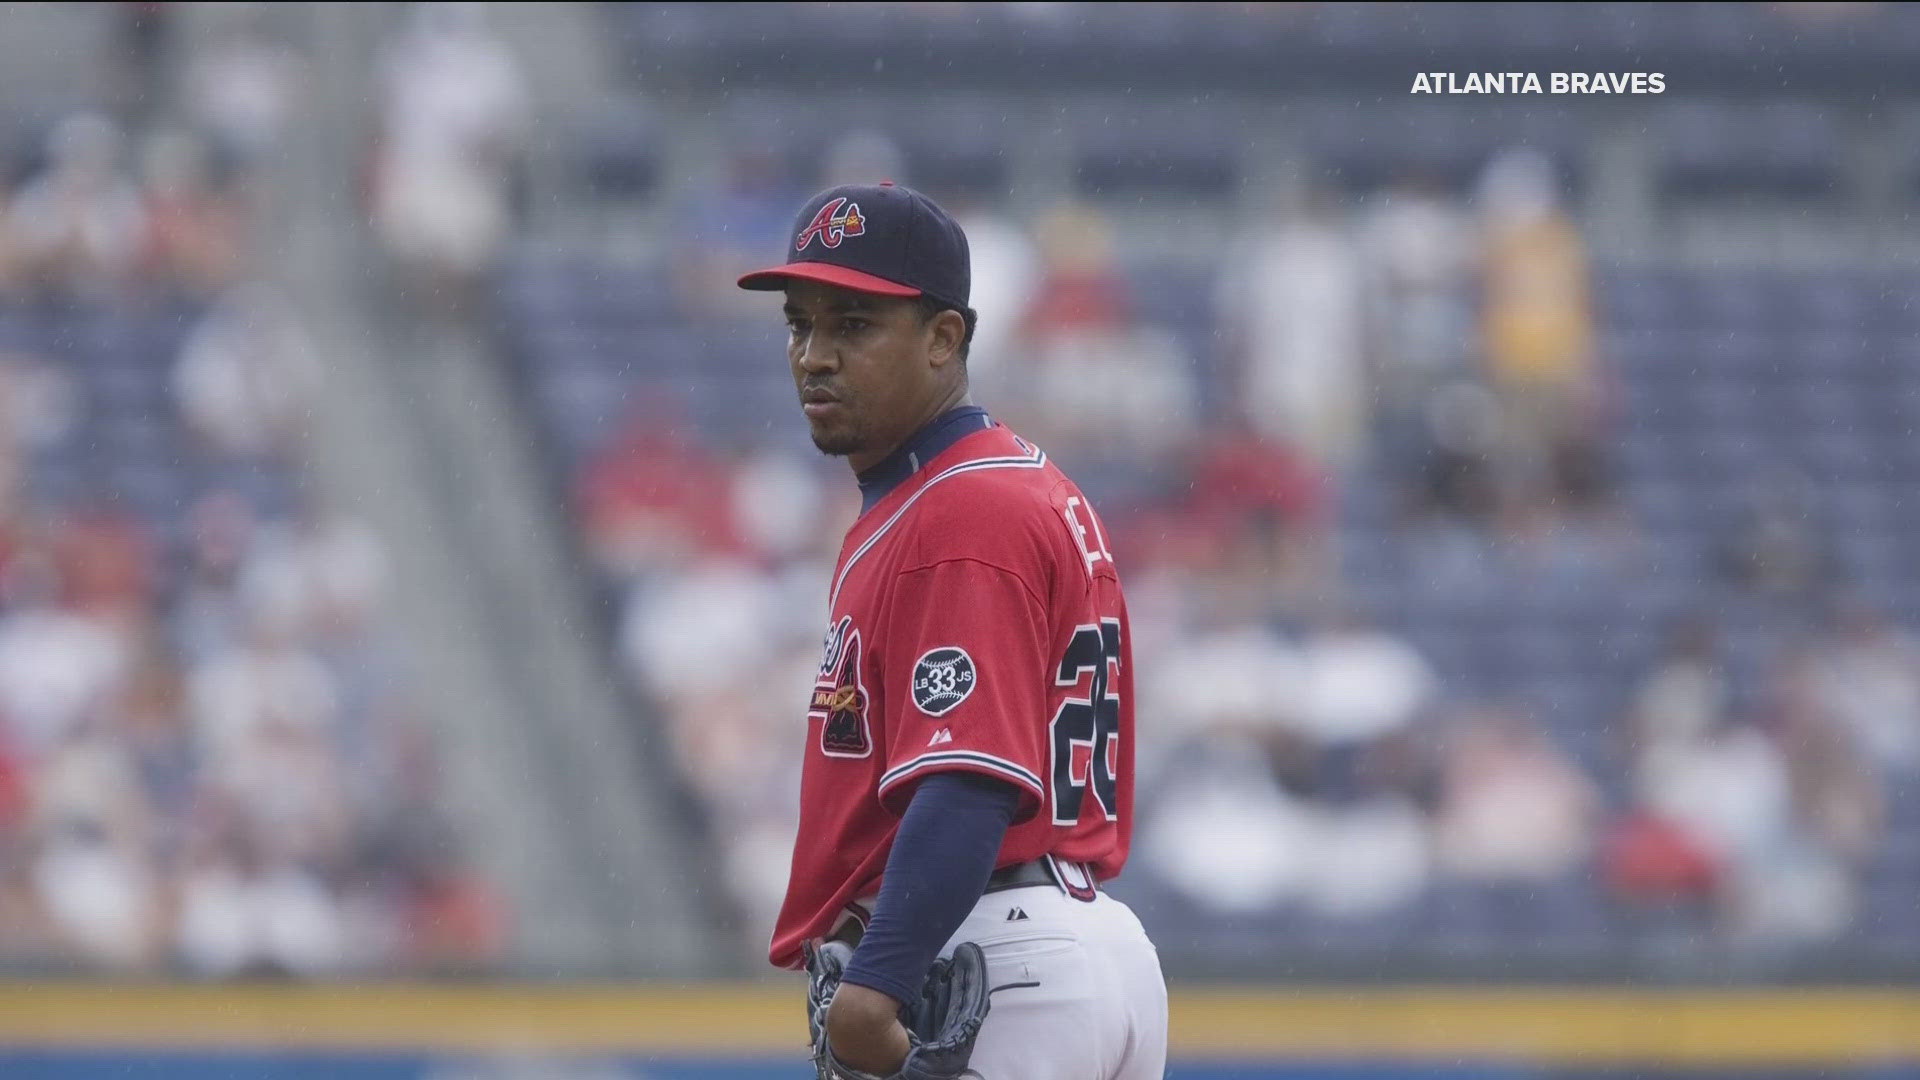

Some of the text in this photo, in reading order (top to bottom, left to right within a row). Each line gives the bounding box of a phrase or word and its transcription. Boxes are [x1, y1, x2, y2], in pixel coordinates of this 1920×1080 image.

[796, 197, 847, 251] A
[915, 666, 972, 694] LB 33 JS
[1049, 616, 1121, 826] 26
